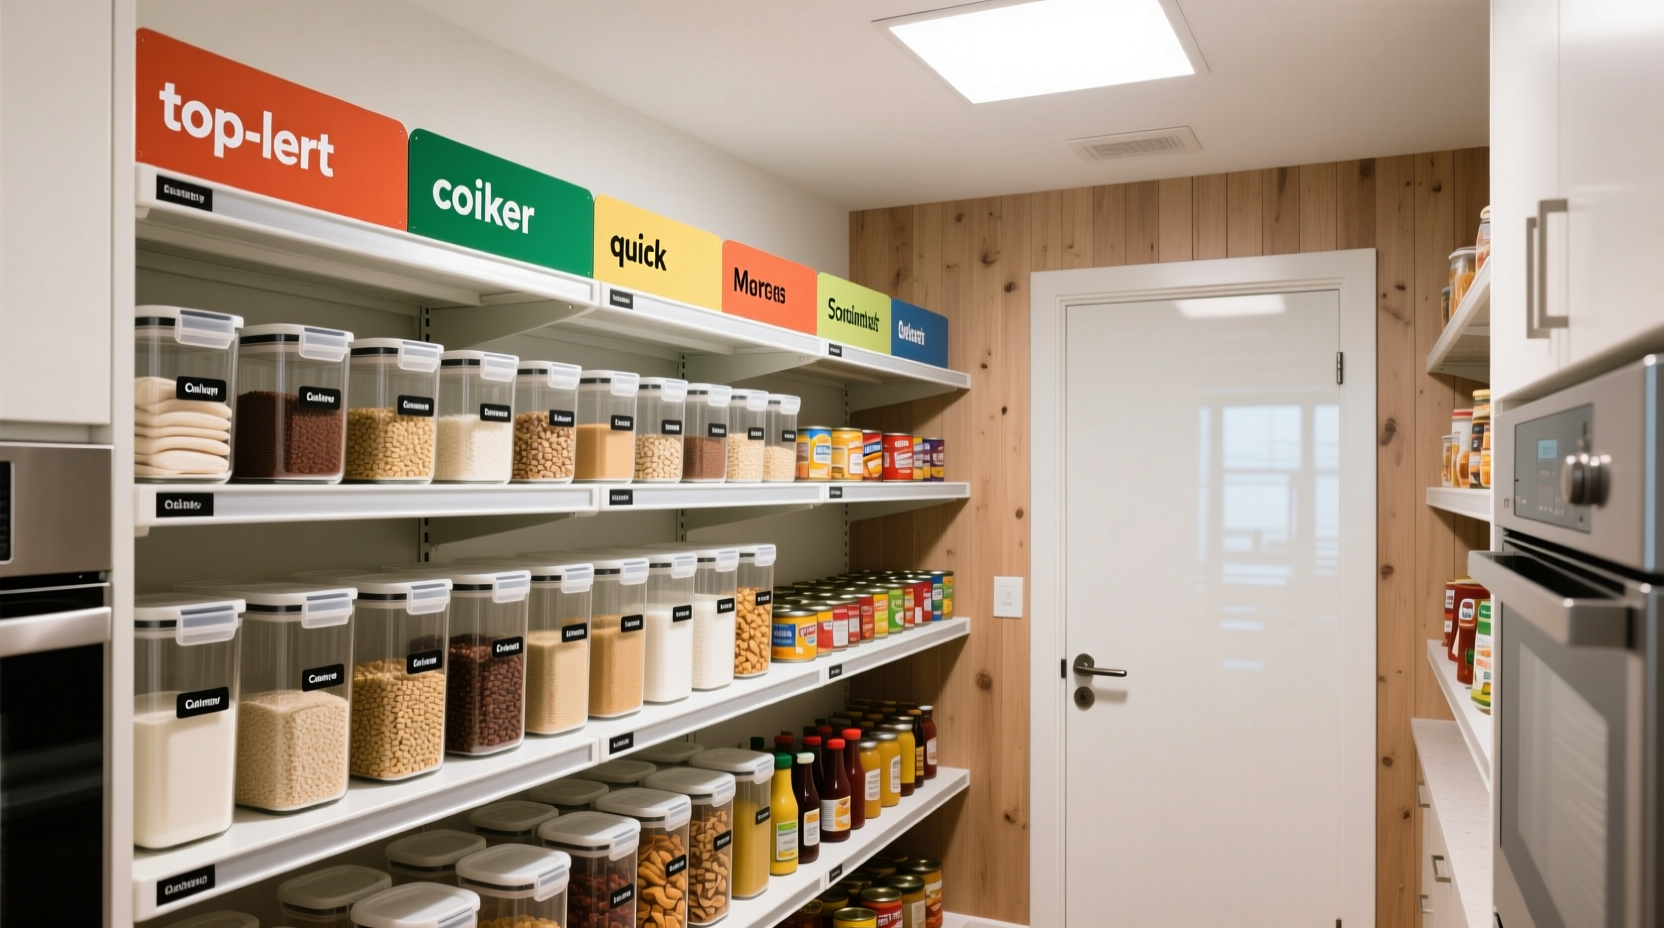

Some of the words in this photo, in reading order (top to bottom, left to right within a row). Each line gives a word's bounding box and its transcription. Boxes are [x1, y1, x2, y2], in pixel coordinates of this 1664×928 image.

[158, 81, 335, 178] top-lert
[432, 178, 535, 234] coiker
[610, 233, 667, 271] quick
